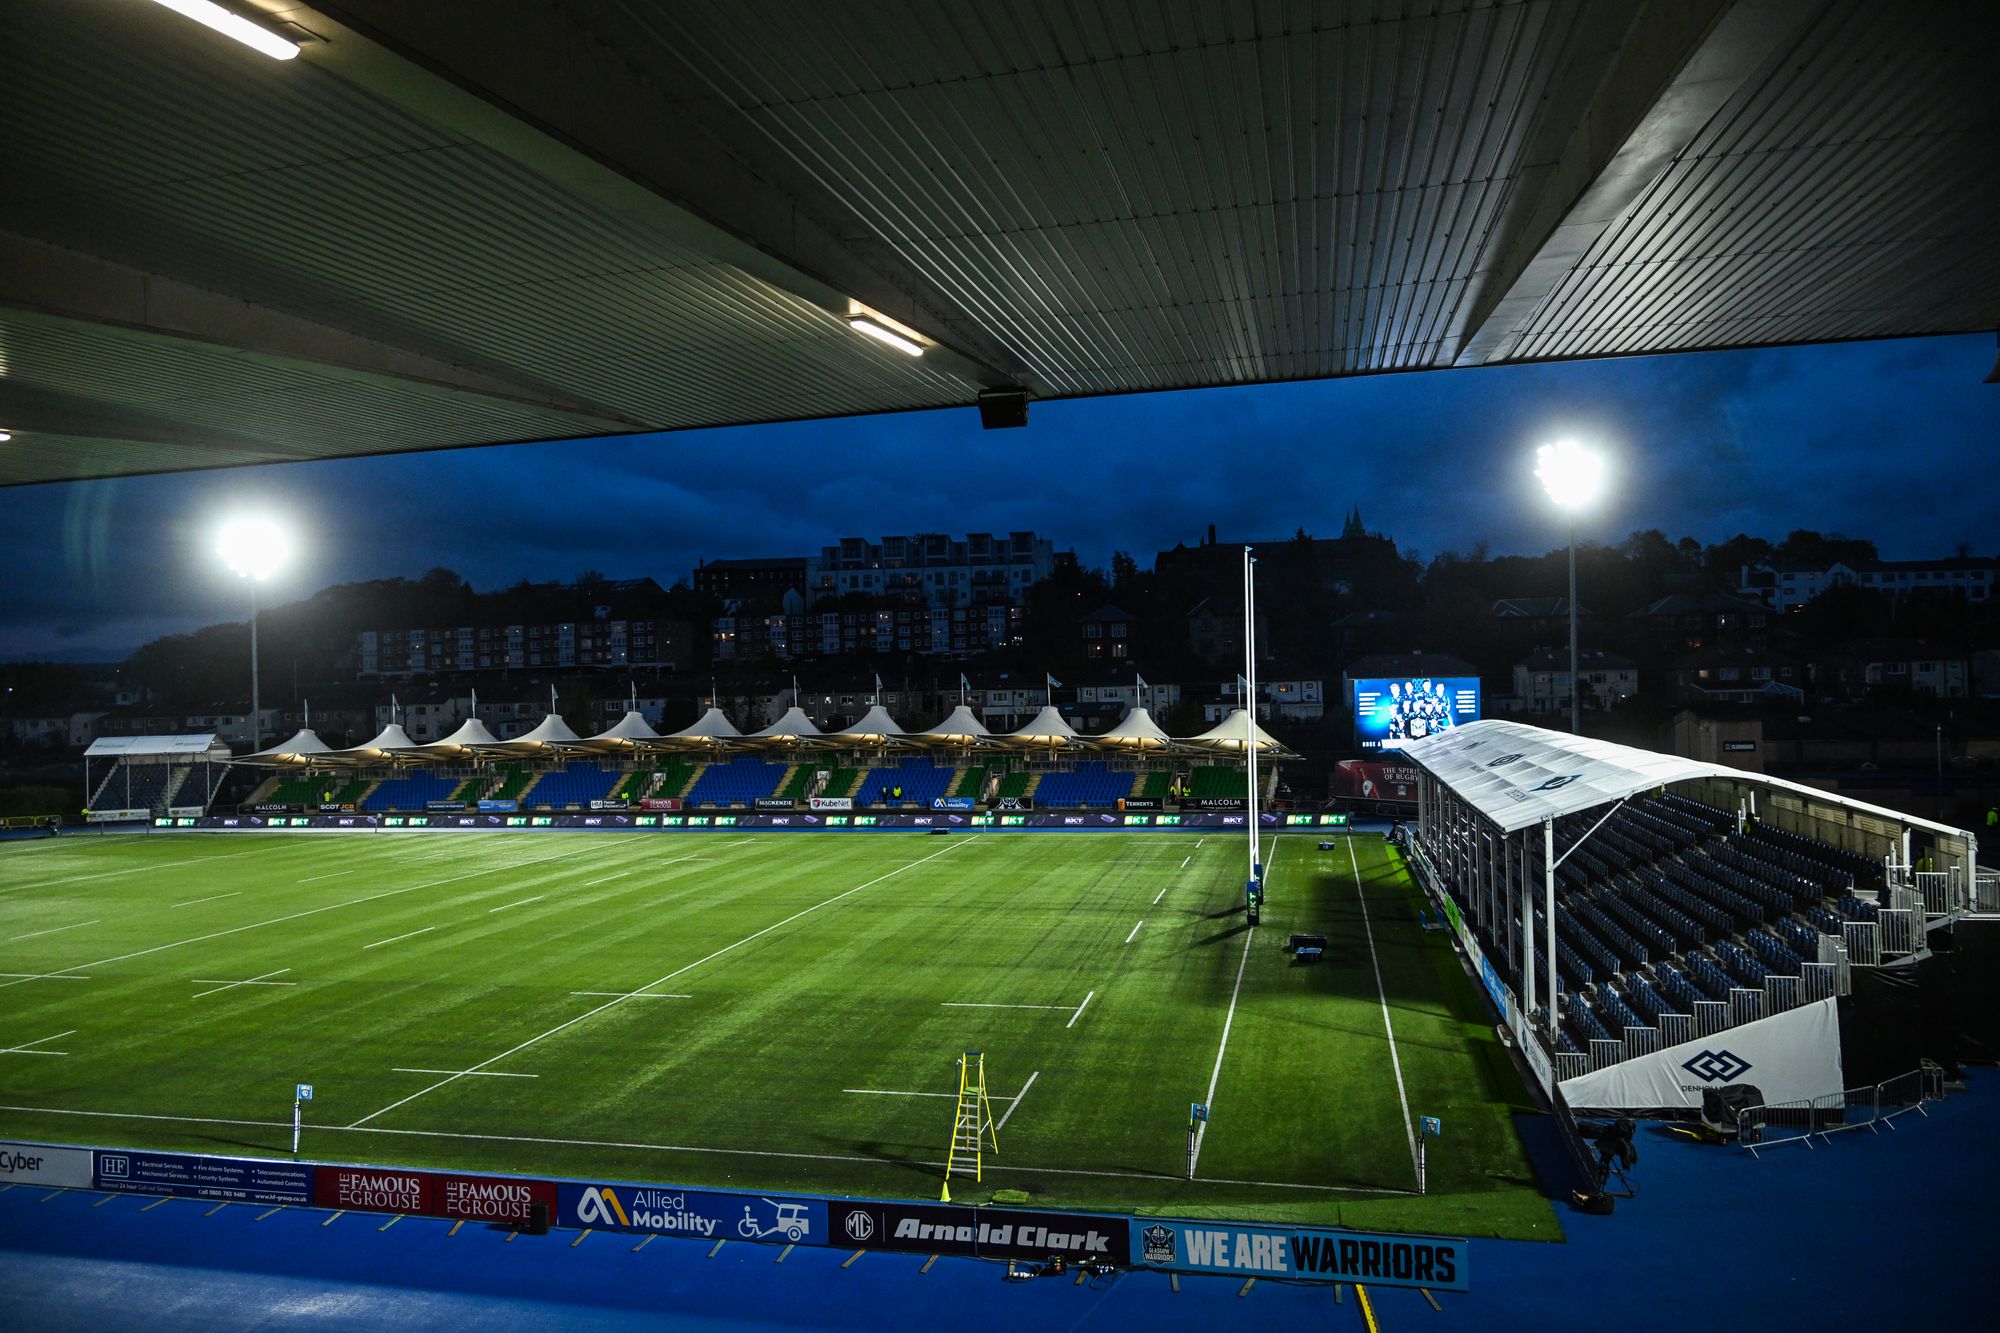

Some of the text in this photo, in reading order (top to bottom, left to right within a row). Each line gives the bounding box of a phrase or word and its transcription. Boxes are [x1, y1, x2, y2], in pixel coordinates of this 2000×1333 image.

[156, 818, 196, 826] BKT BKT
[268, 818, 309, 826] BKT BKT
[385, 818, 428, 826] BKT BKT
[507, 818, 552, 826] BKT BKT
[636, 817, 736, 826] BKT BKT BKT BKT
[826, 816, 876, 826] BKT BKT
[1001, 816, 1025, 825] BKT
[1124, 816, 1181, 825] BKT BKT
[1223, 816, 1243, 824] BKT
[1286, 815, 1346, 825] BKT BKT
[0, 1151, 43, 1173] Cyber
[104, 1159, 126, 1173] HF
[340, 1173, 350, 1203] THE
[351, 1174, 420, 1194] FAMOUS
[350, 1191, 420, 1210] GROUSE
[447, 1182, 458, 1212] THE
[459, 1183, 531, 1202] FAMOUS
[633, 1191, 685, 1210] Allied
[458, 1199, 531, 1218] GROUSE
[633, 1211, 716, 1236] Mobility
[849, 1214, 870, 1237] MG
[894, 1218, 1109, 1252] Arnold Clark
[1144, 1252, 1174, 1261] WARRIORS
[1184, 1230, 1456, 1283] WE ARE WARRIORS
